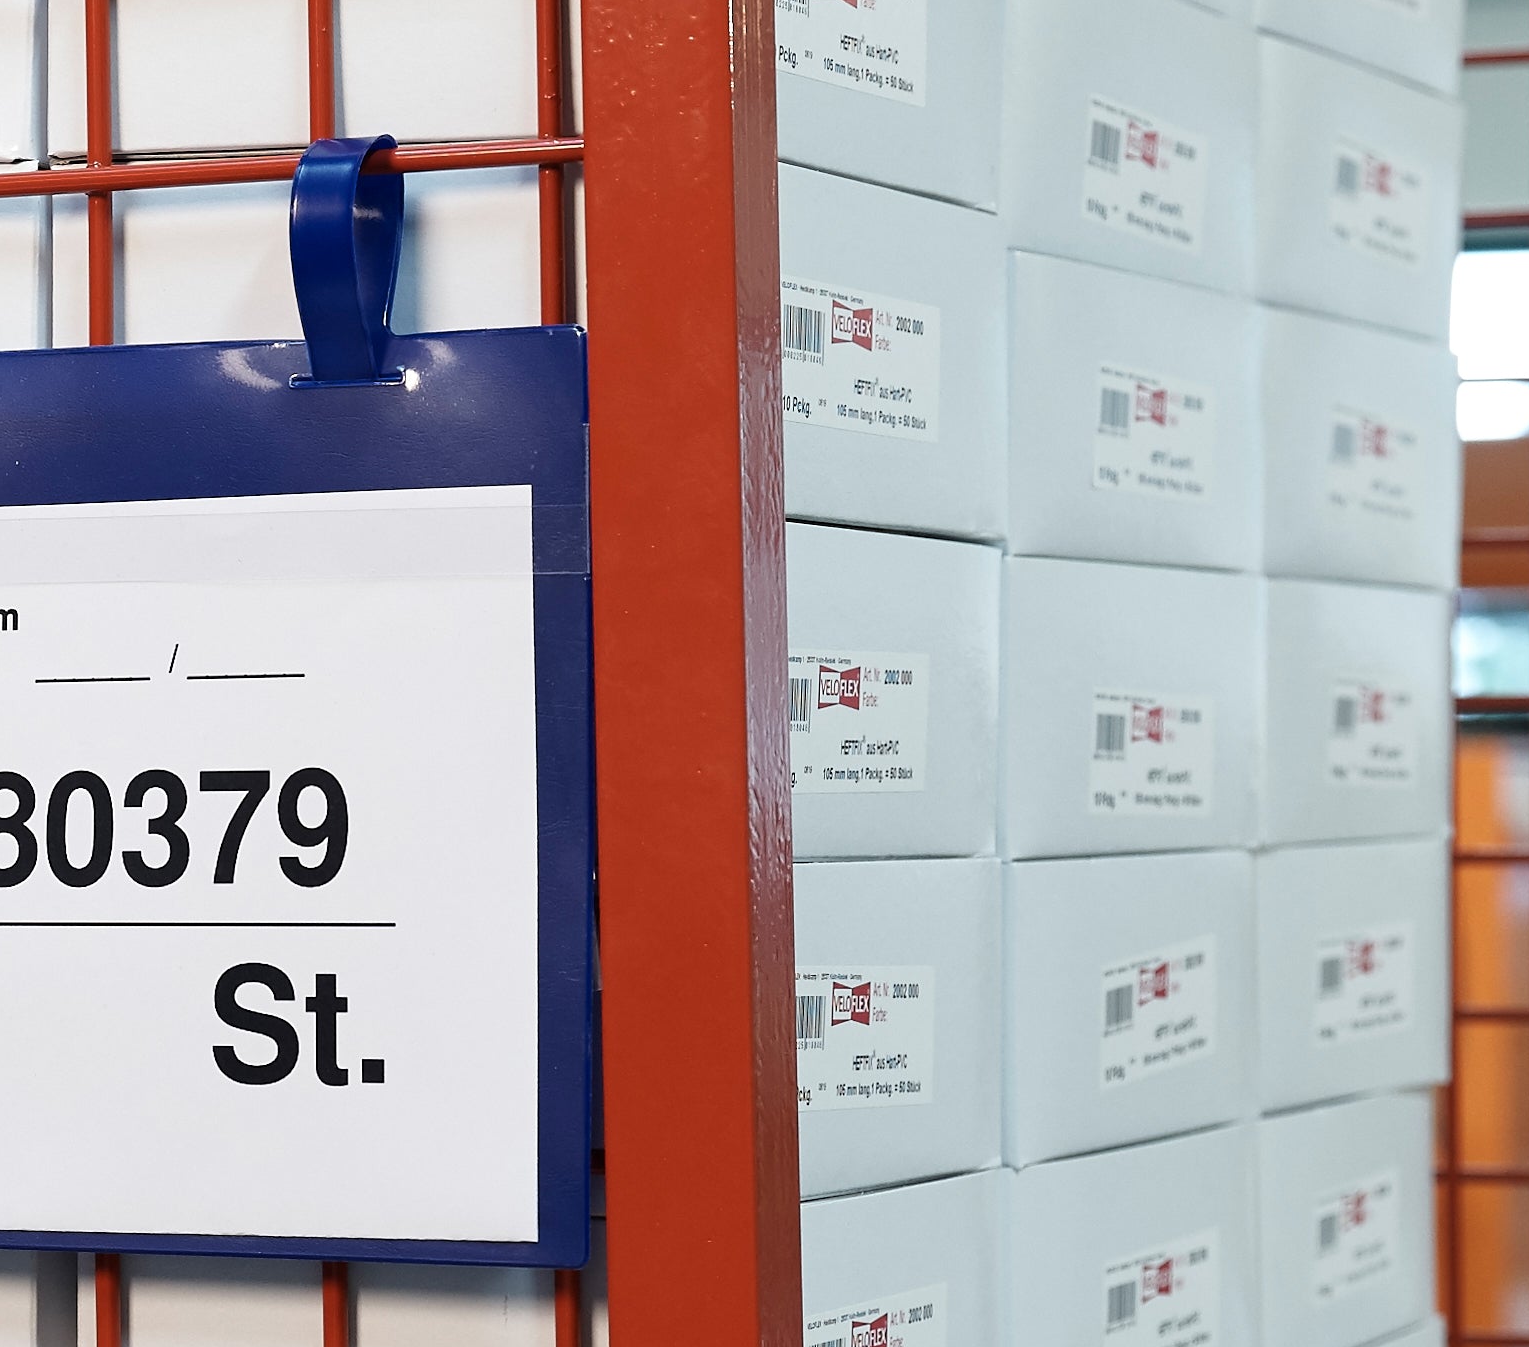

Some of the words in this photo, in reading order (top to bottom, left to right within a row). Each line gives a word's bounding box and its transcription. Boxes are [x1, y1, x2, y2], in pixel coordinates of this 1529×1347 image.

[778, 44, 798, 68] Pckg.
[823, 57, 833, 71] 105
[833, 314, 871, 339] VELOFLEX
[895, 315, 911, 333] 2002
[783, 395, 791, 412] 10
[792, 396, 811, 418] Pckg.
[836, 403, 846, 417] 105
[884, 669, 899, 685] 2002
[820, 679, 858, 697] VELOFLEX
[822, 767, 833, 780] 105
[892, 983, 907, 998] 2002
[833, 994, 869, 1014] VELOFLEX
[213, 963, 384, 1086] St.
[797, 1085, 813, 1106] ckg.
[836, 1083, 845, 1096] 105
